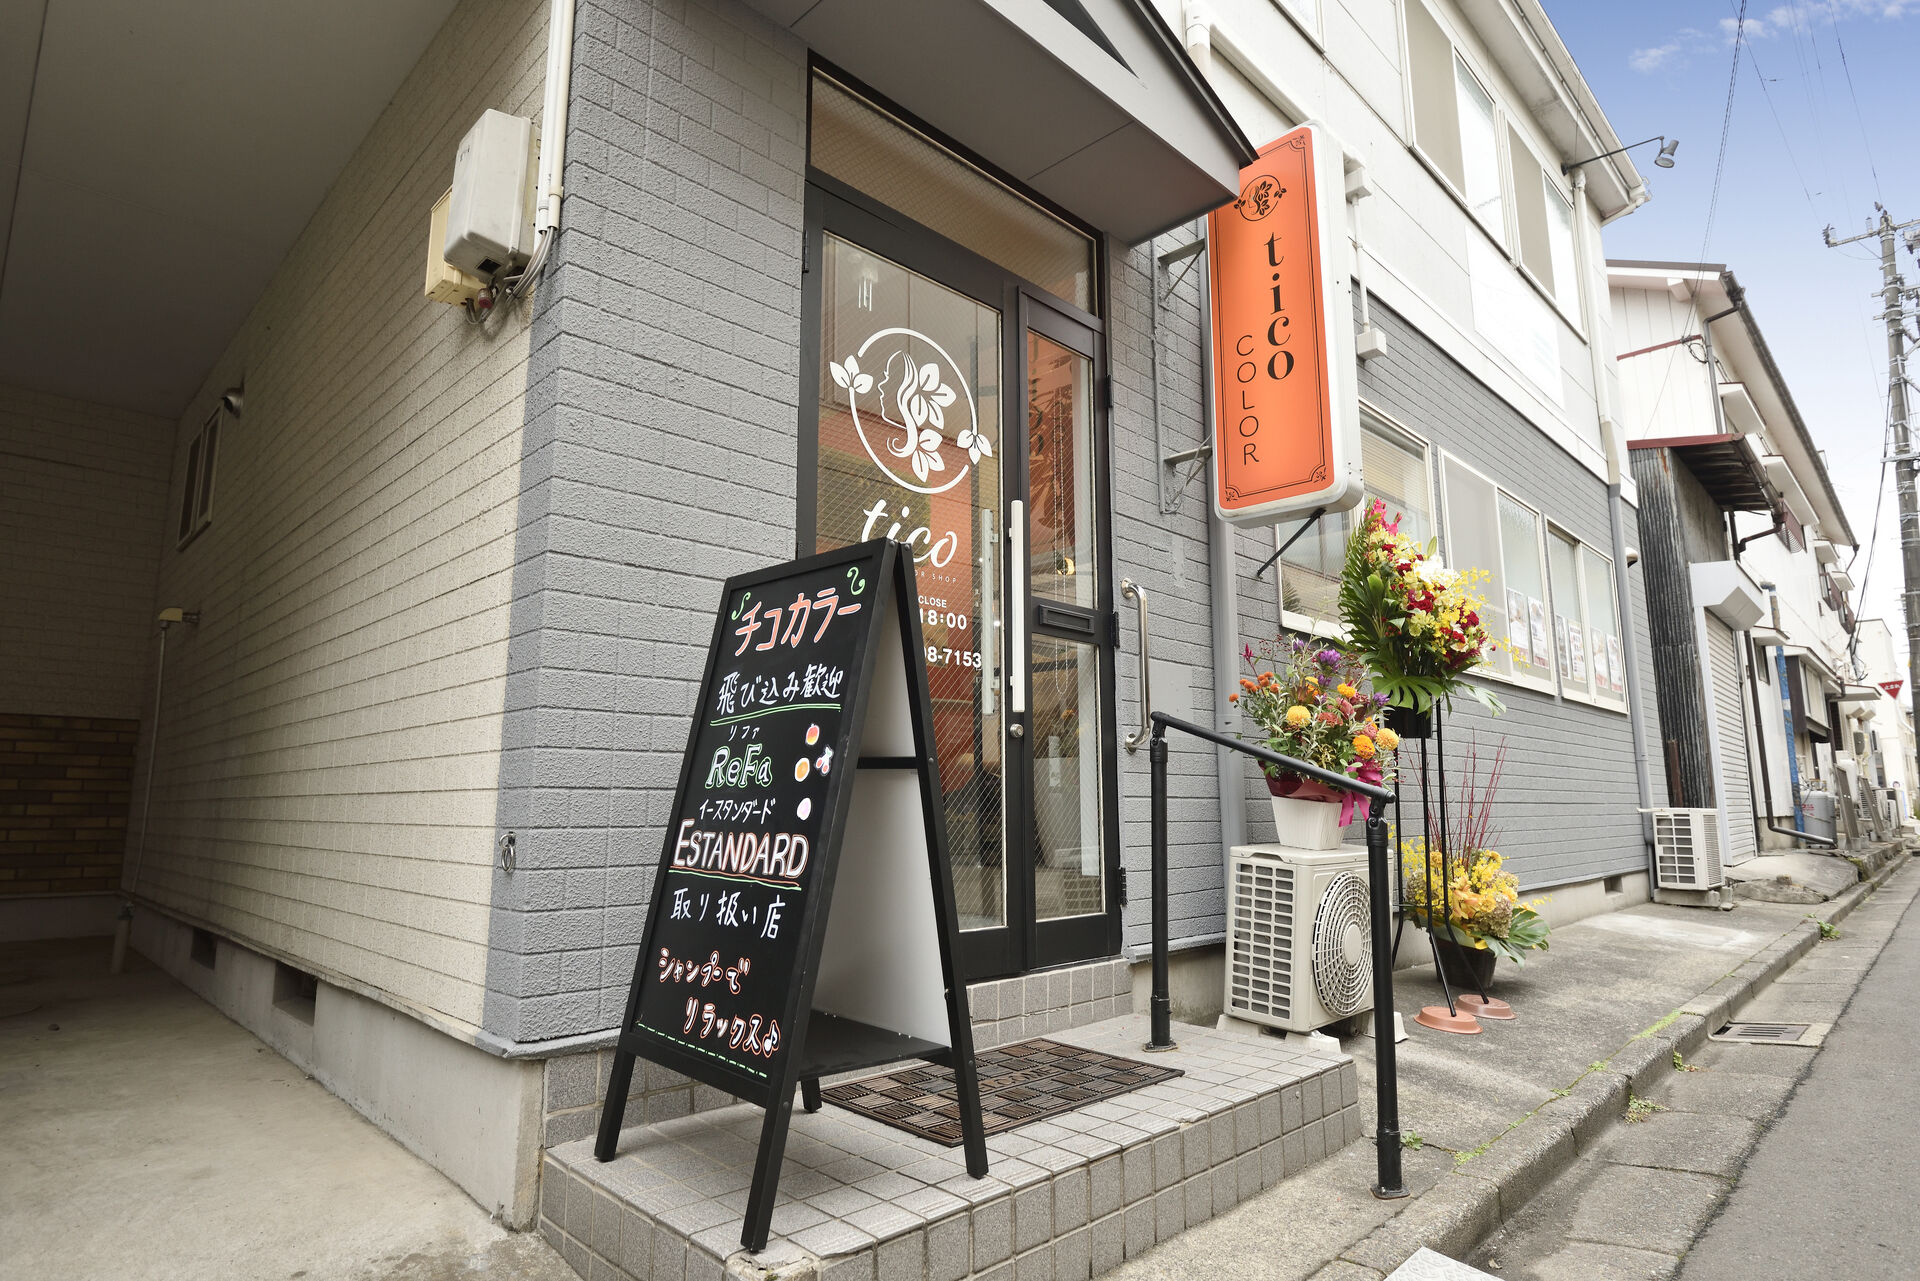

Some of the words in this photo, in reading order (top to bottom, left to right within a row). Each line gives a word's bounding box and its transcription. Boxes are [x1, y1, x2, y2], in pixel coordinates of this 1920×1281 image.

[1263, 232, 1294, 380] tico
[1236, 334, 1260, 466] COLOR
[861, 499, 958, 568] tico
[917, 595, 947, 608] CLOSE
[932, 573, 957, 583] SHOP
[735, 587, 862, 657] チコカラー
[919, 607, 967, 630] 18:00
[924, 645, 982, 668] 8-7153
[717, 663, 844, 716] 飛び込み歓迎
[728, 725, 761, 742] リファ
[704, 743, 773, 790] ReFa
[699, 797, 777, 826] イースタンダード
[672, 818, 810, 879] ESTANDARD
[670, 887, 787, 940] 取り扱い店
[658, 947, 752, 995] シャンプーで
